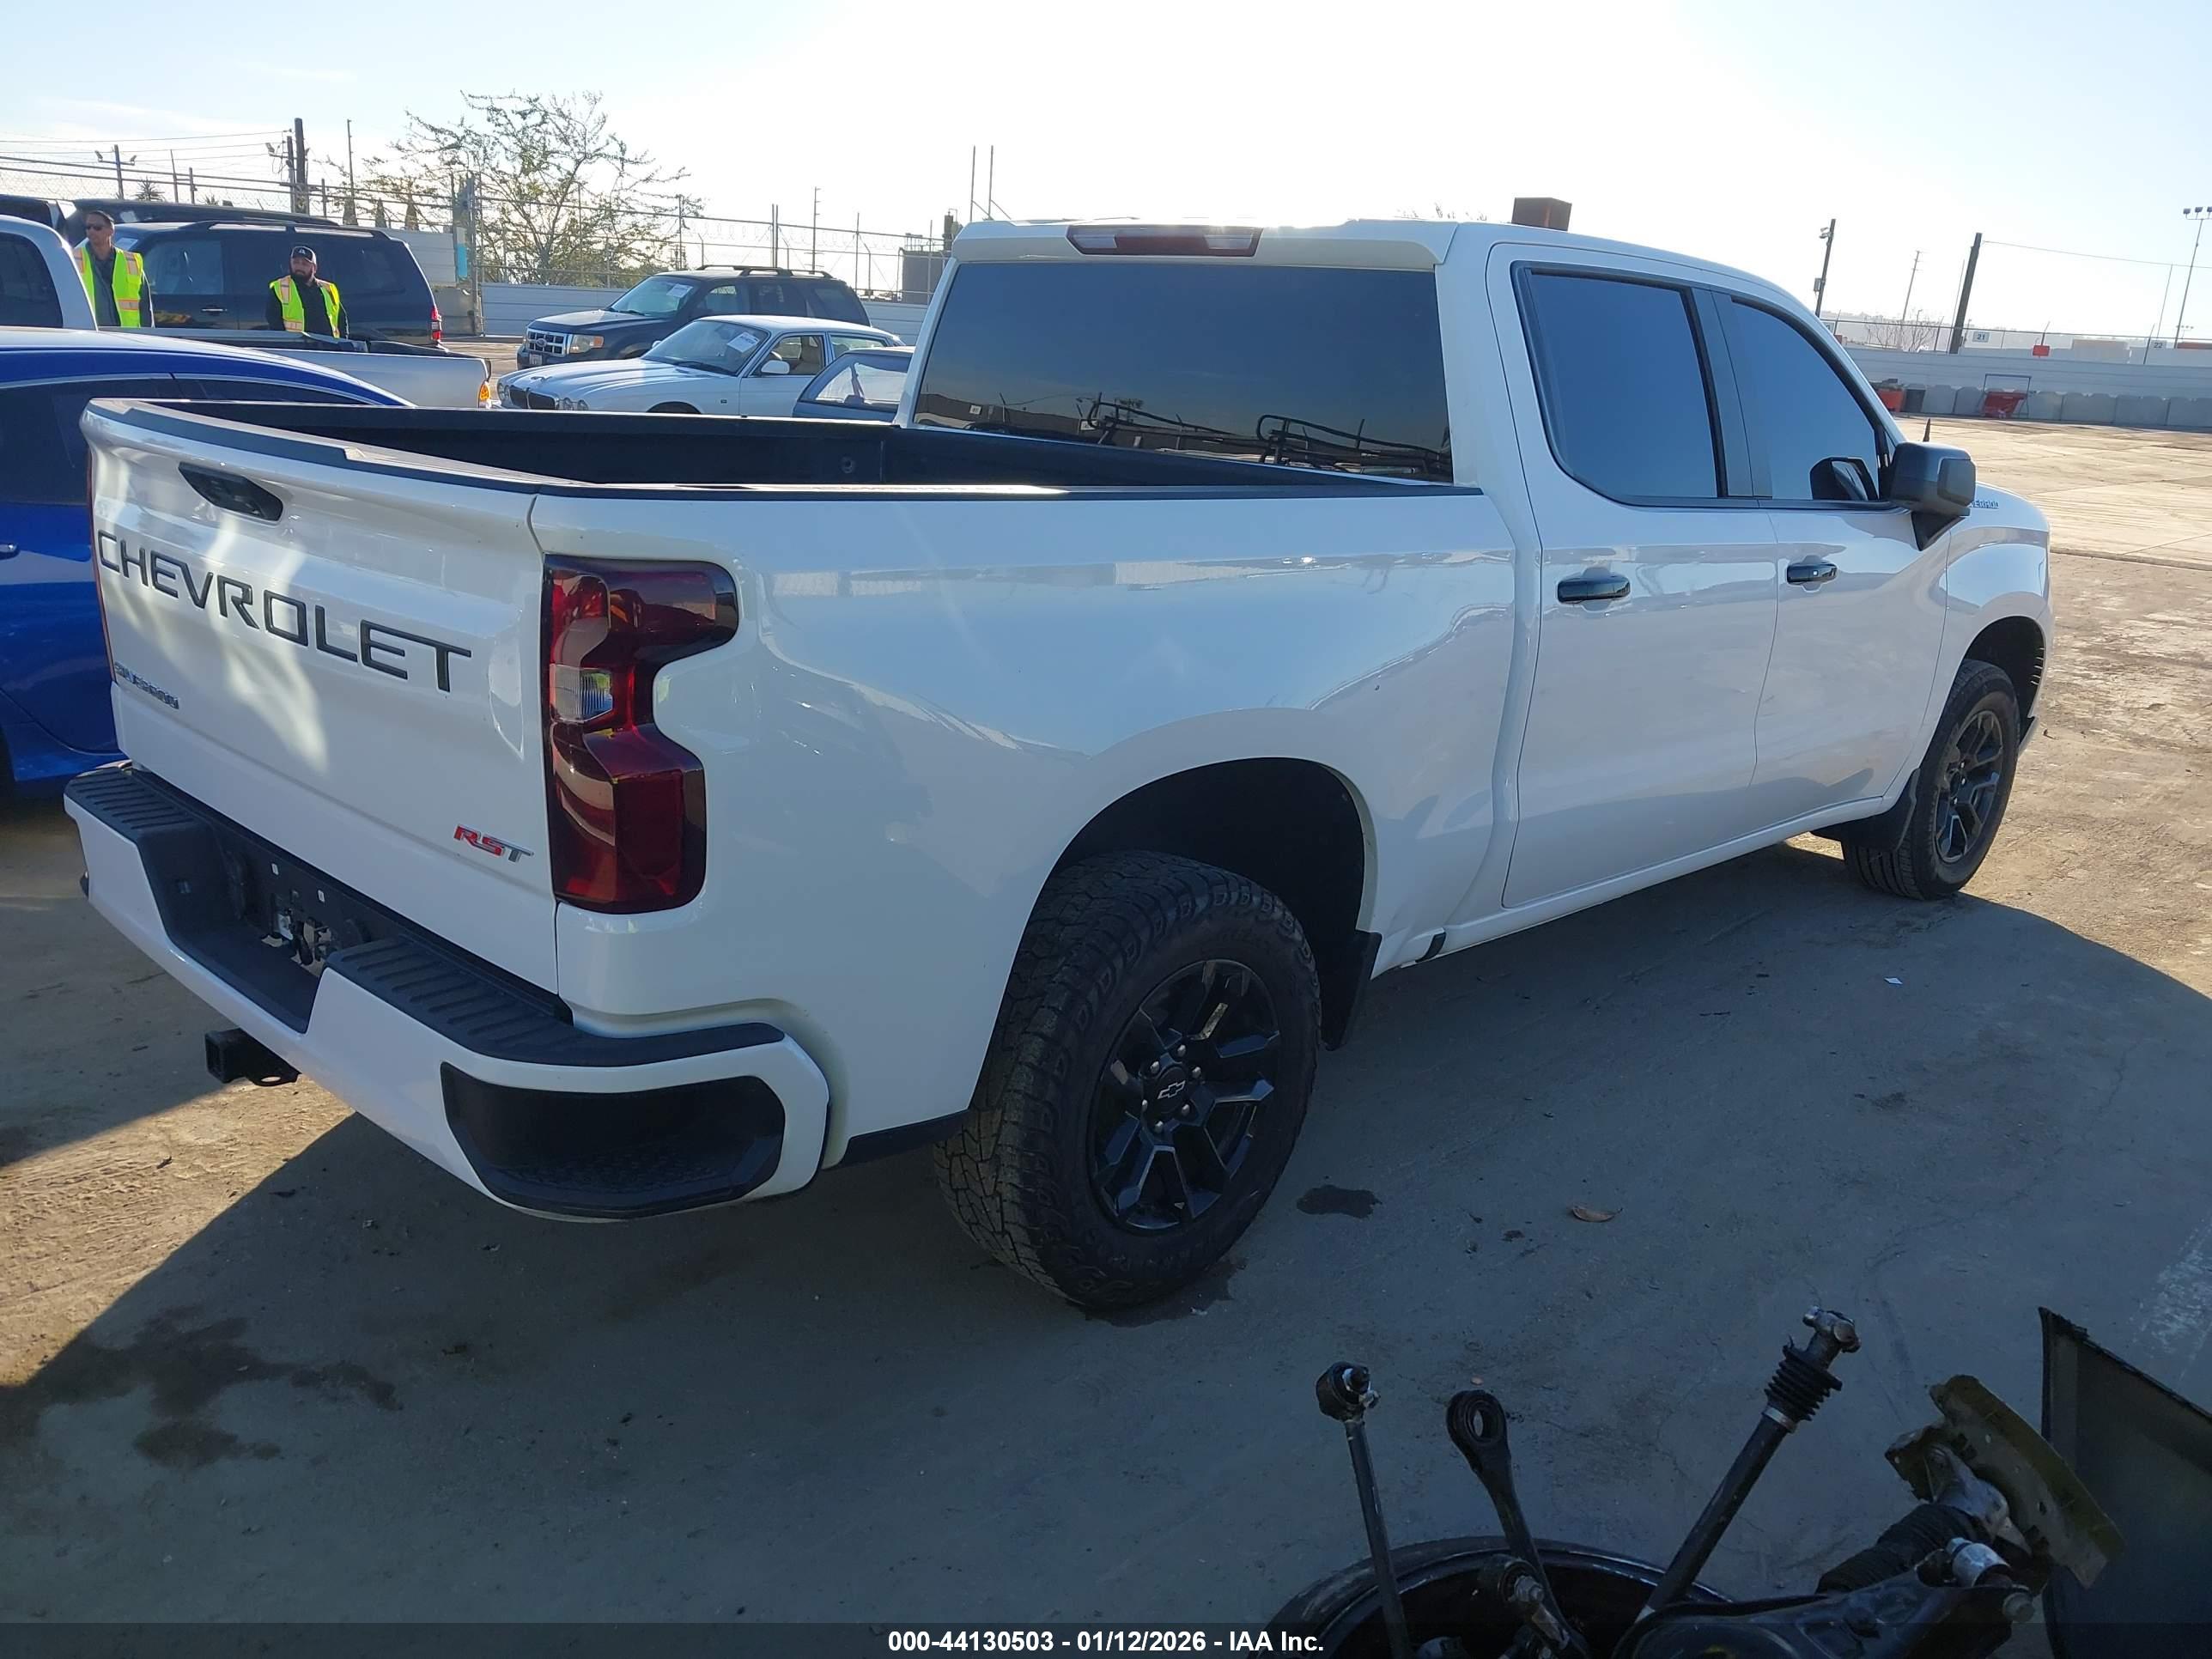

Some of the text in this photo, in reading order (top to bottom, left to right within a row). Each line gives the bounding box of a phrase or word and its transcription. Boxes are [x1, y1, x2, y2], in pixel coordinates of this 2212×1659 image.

[1976, 332, 1985, 341] 21
[97, 529, 472, 693] CHEVROLET
[453, 824, 534, 863] RST
